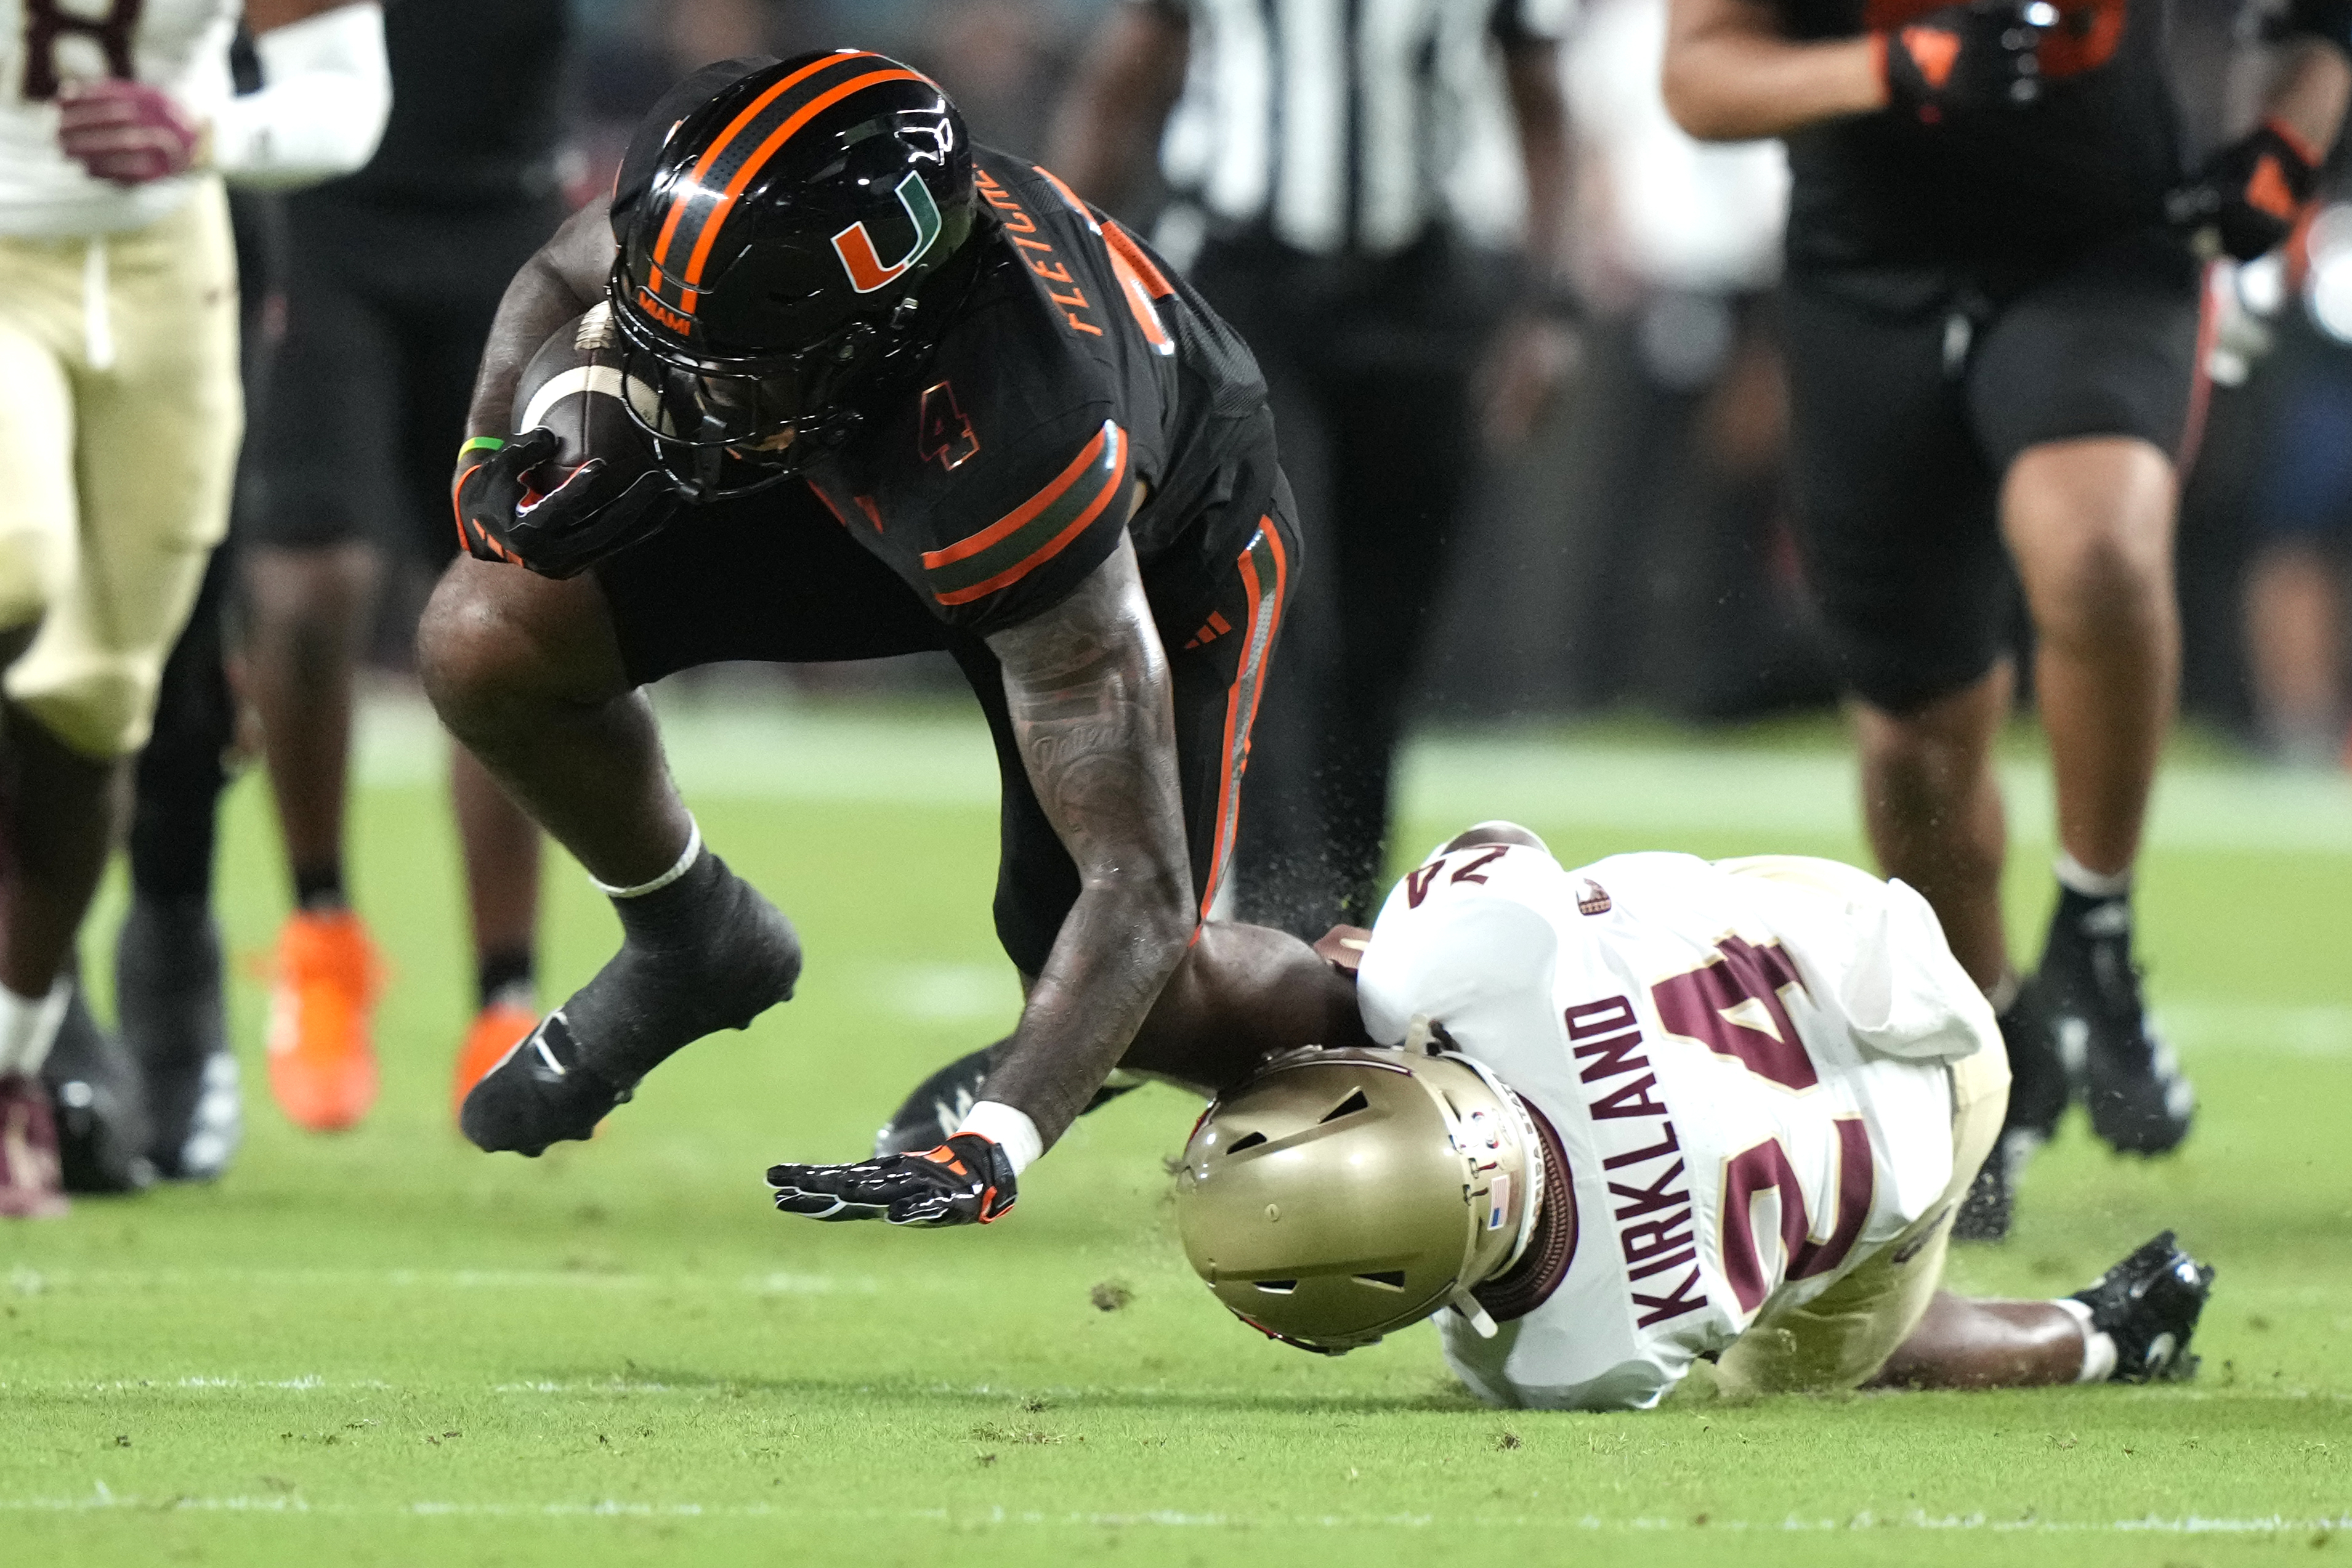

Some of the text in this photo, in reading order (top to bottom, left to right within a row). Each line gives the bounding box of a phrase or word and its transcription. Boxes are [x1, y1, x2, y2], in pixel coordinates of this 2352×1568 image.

[830, 169, 942, 294] U
[639, 291, 691, 336] MIAMI
[918, 380, 980, 471] 4
[1564, 995, 1708, 1330] KIRKLAND
[1650, 927, 1877, 1318] 24
